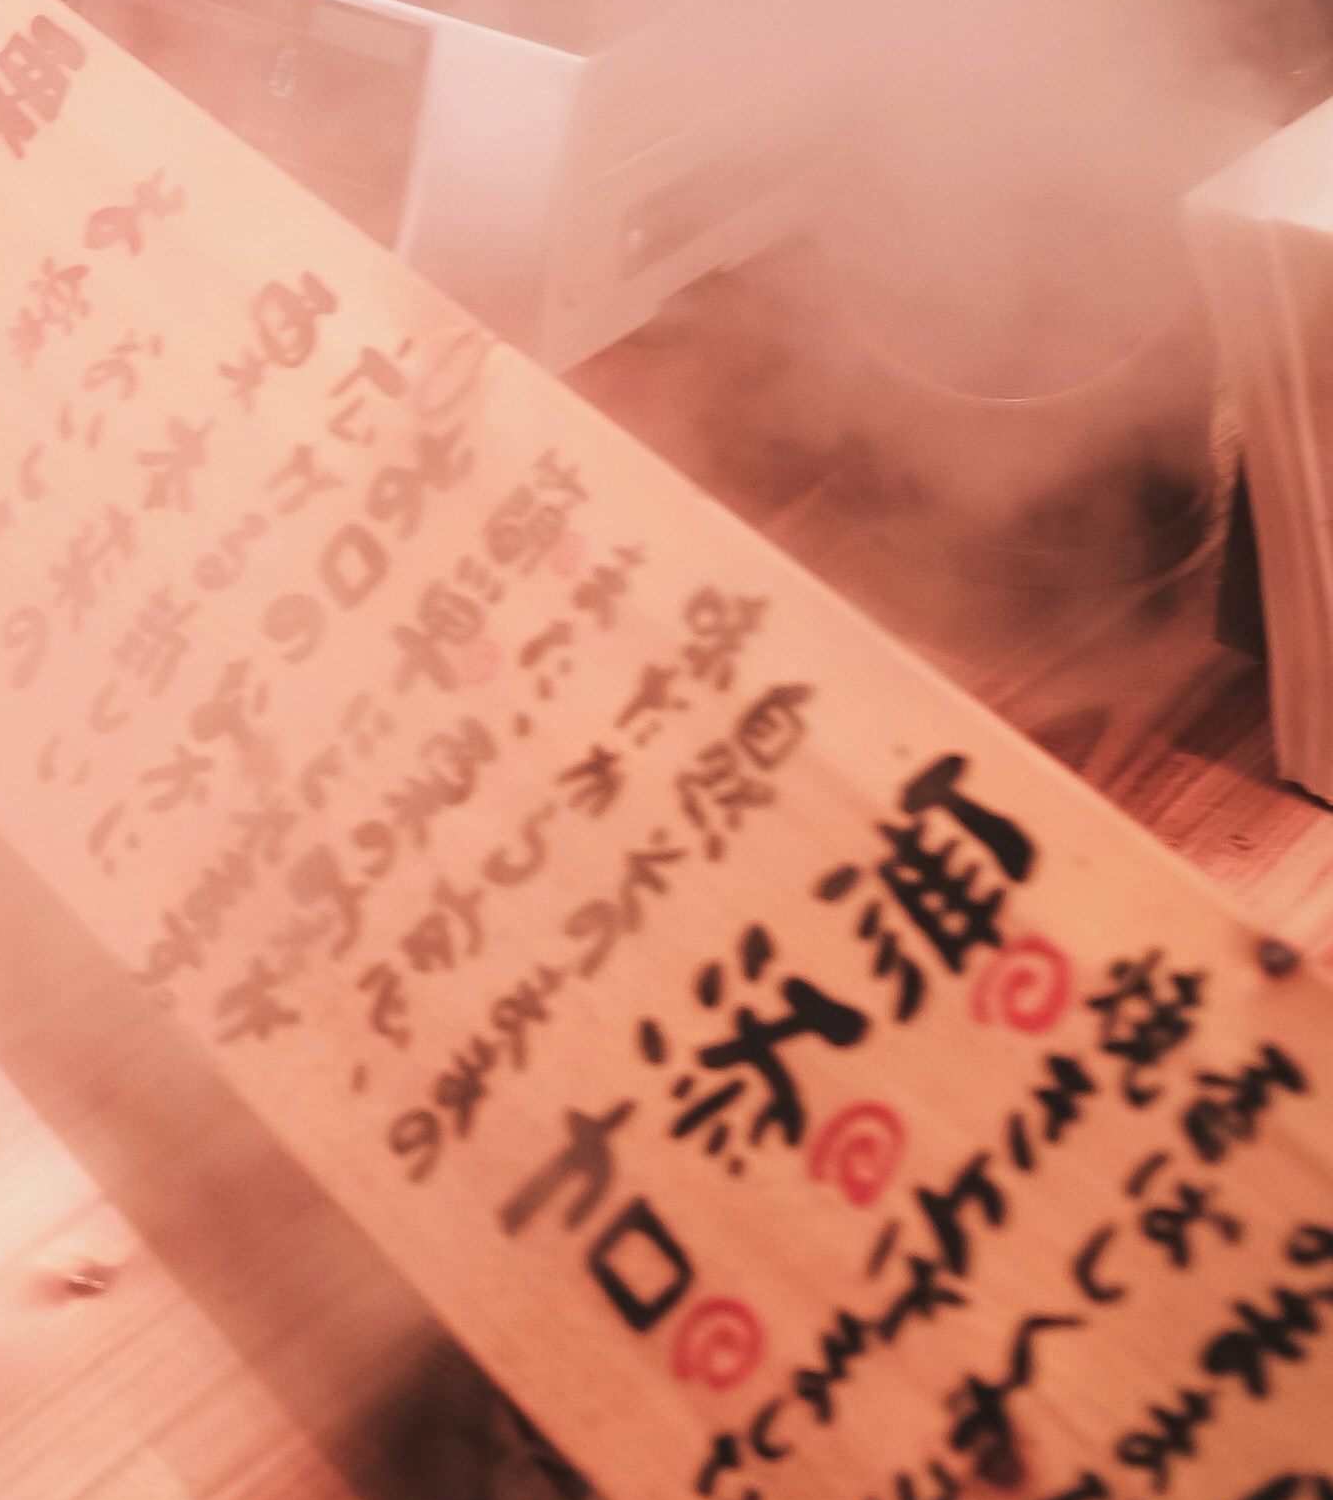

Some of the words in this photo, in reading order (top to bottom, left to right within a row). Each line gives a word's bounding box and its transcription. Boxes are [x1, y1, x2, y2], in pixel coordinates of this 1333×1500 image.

[1, 272, 337, 689] 栗本来の
[387, 683, 810, 1182] 自然そのままの
[499, 754, 1035, 1335] 無添加
